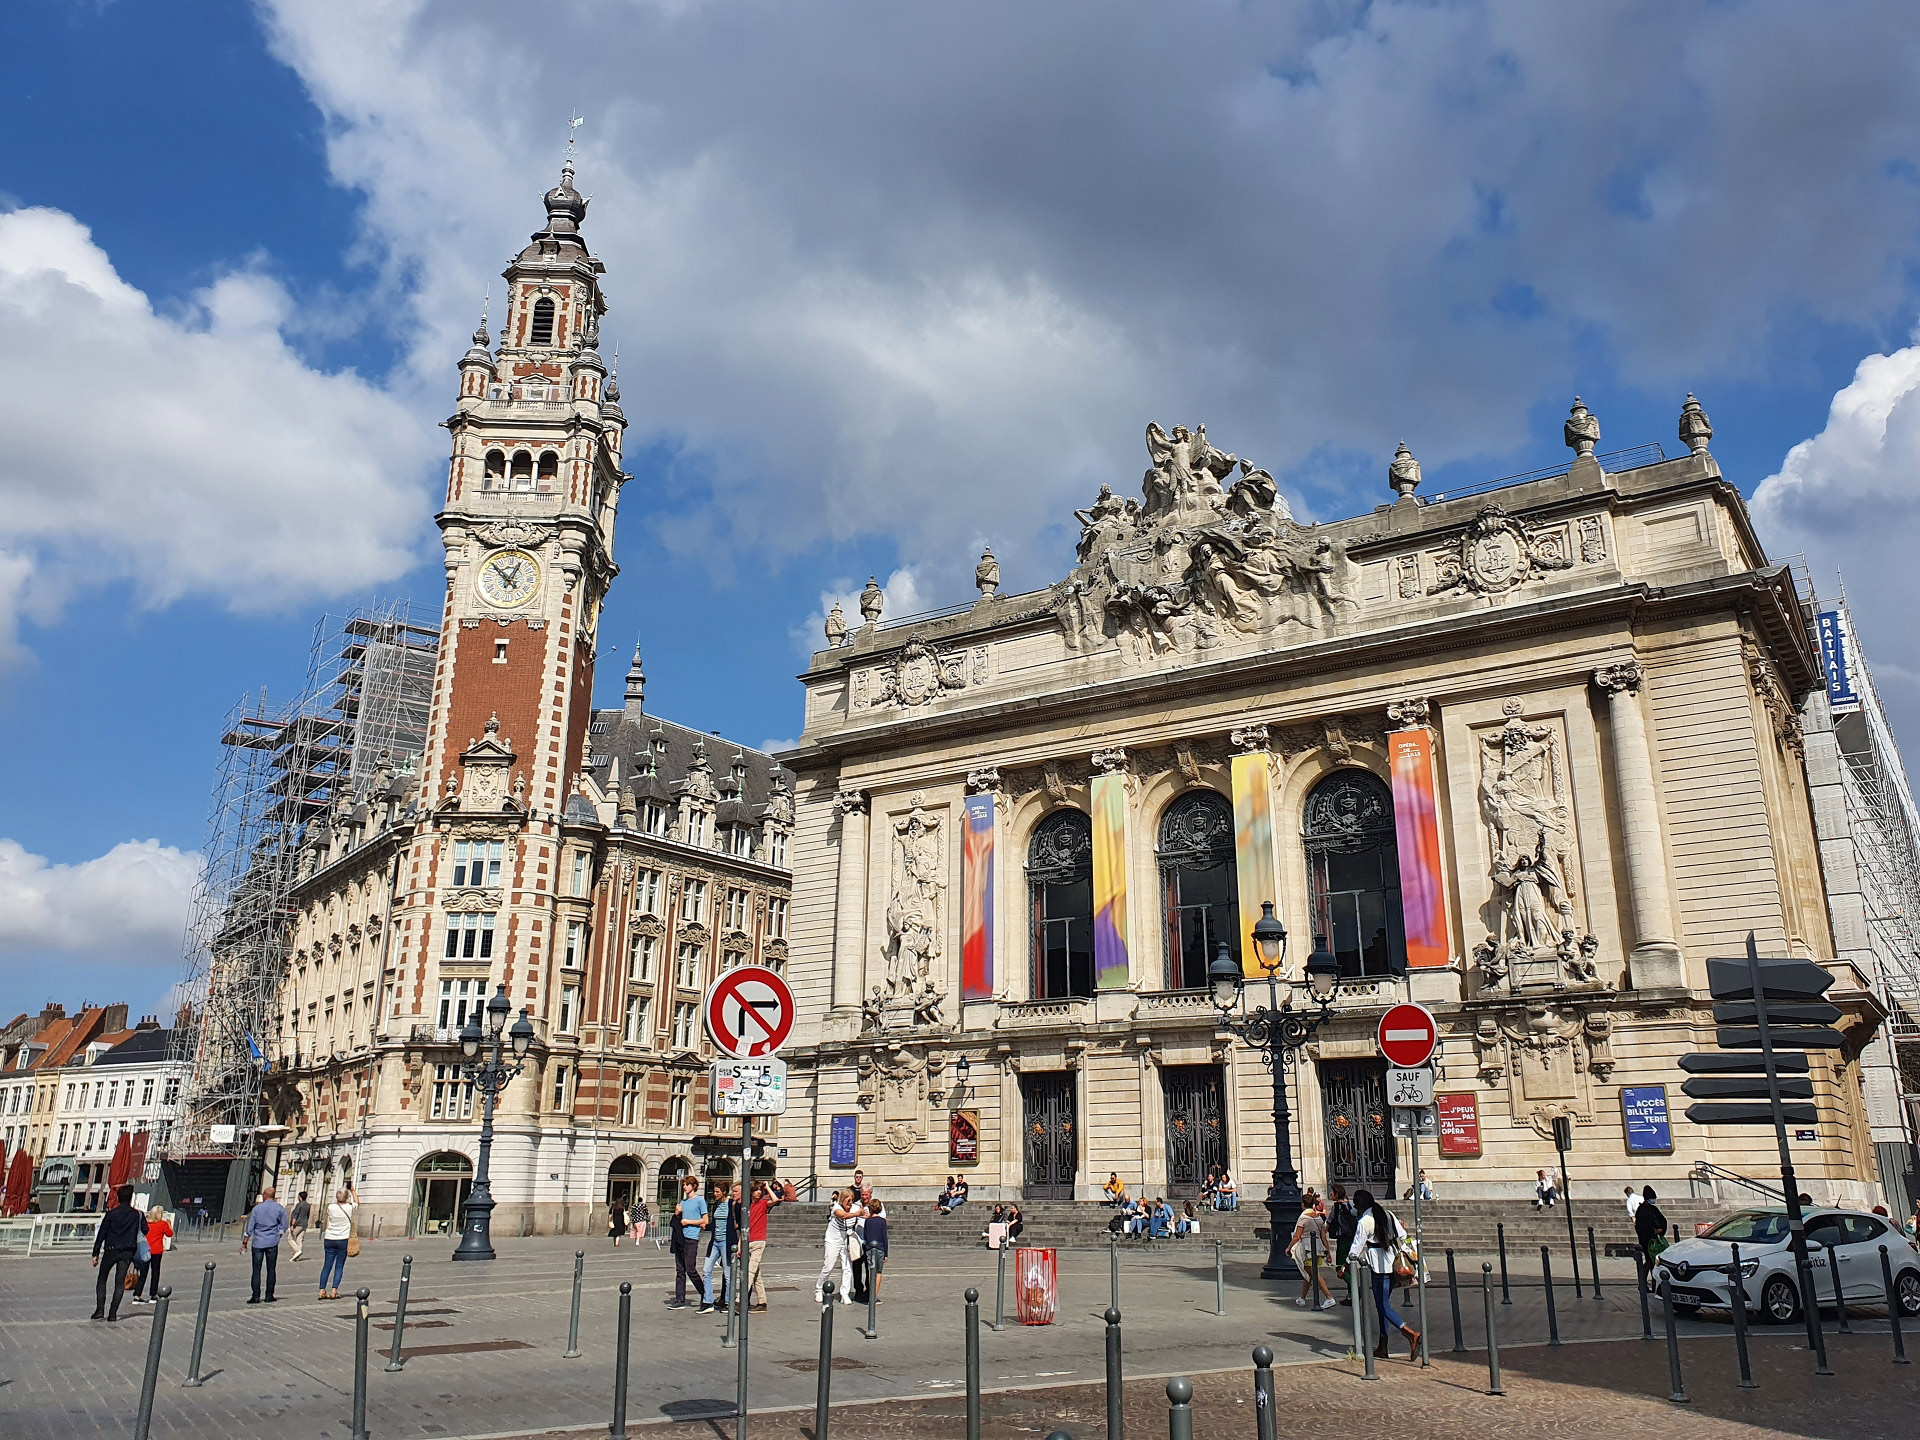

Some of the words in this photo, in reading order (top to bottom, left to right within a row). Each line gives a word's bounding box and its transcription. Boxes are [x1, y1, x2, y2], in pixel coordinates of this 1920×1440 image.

[1821, 618, 1841, 691] BATTAIS
[1396, 1072, 1420, 1081] SAUF
[1636, 1098, 1665, 1107] ACCÈS
[1626, 1107, 1654, 1116] BILLET
[1644, 1115, 1668, 1123] TERIE
[1441, 1127, 1465, 1135] OPÉRA
